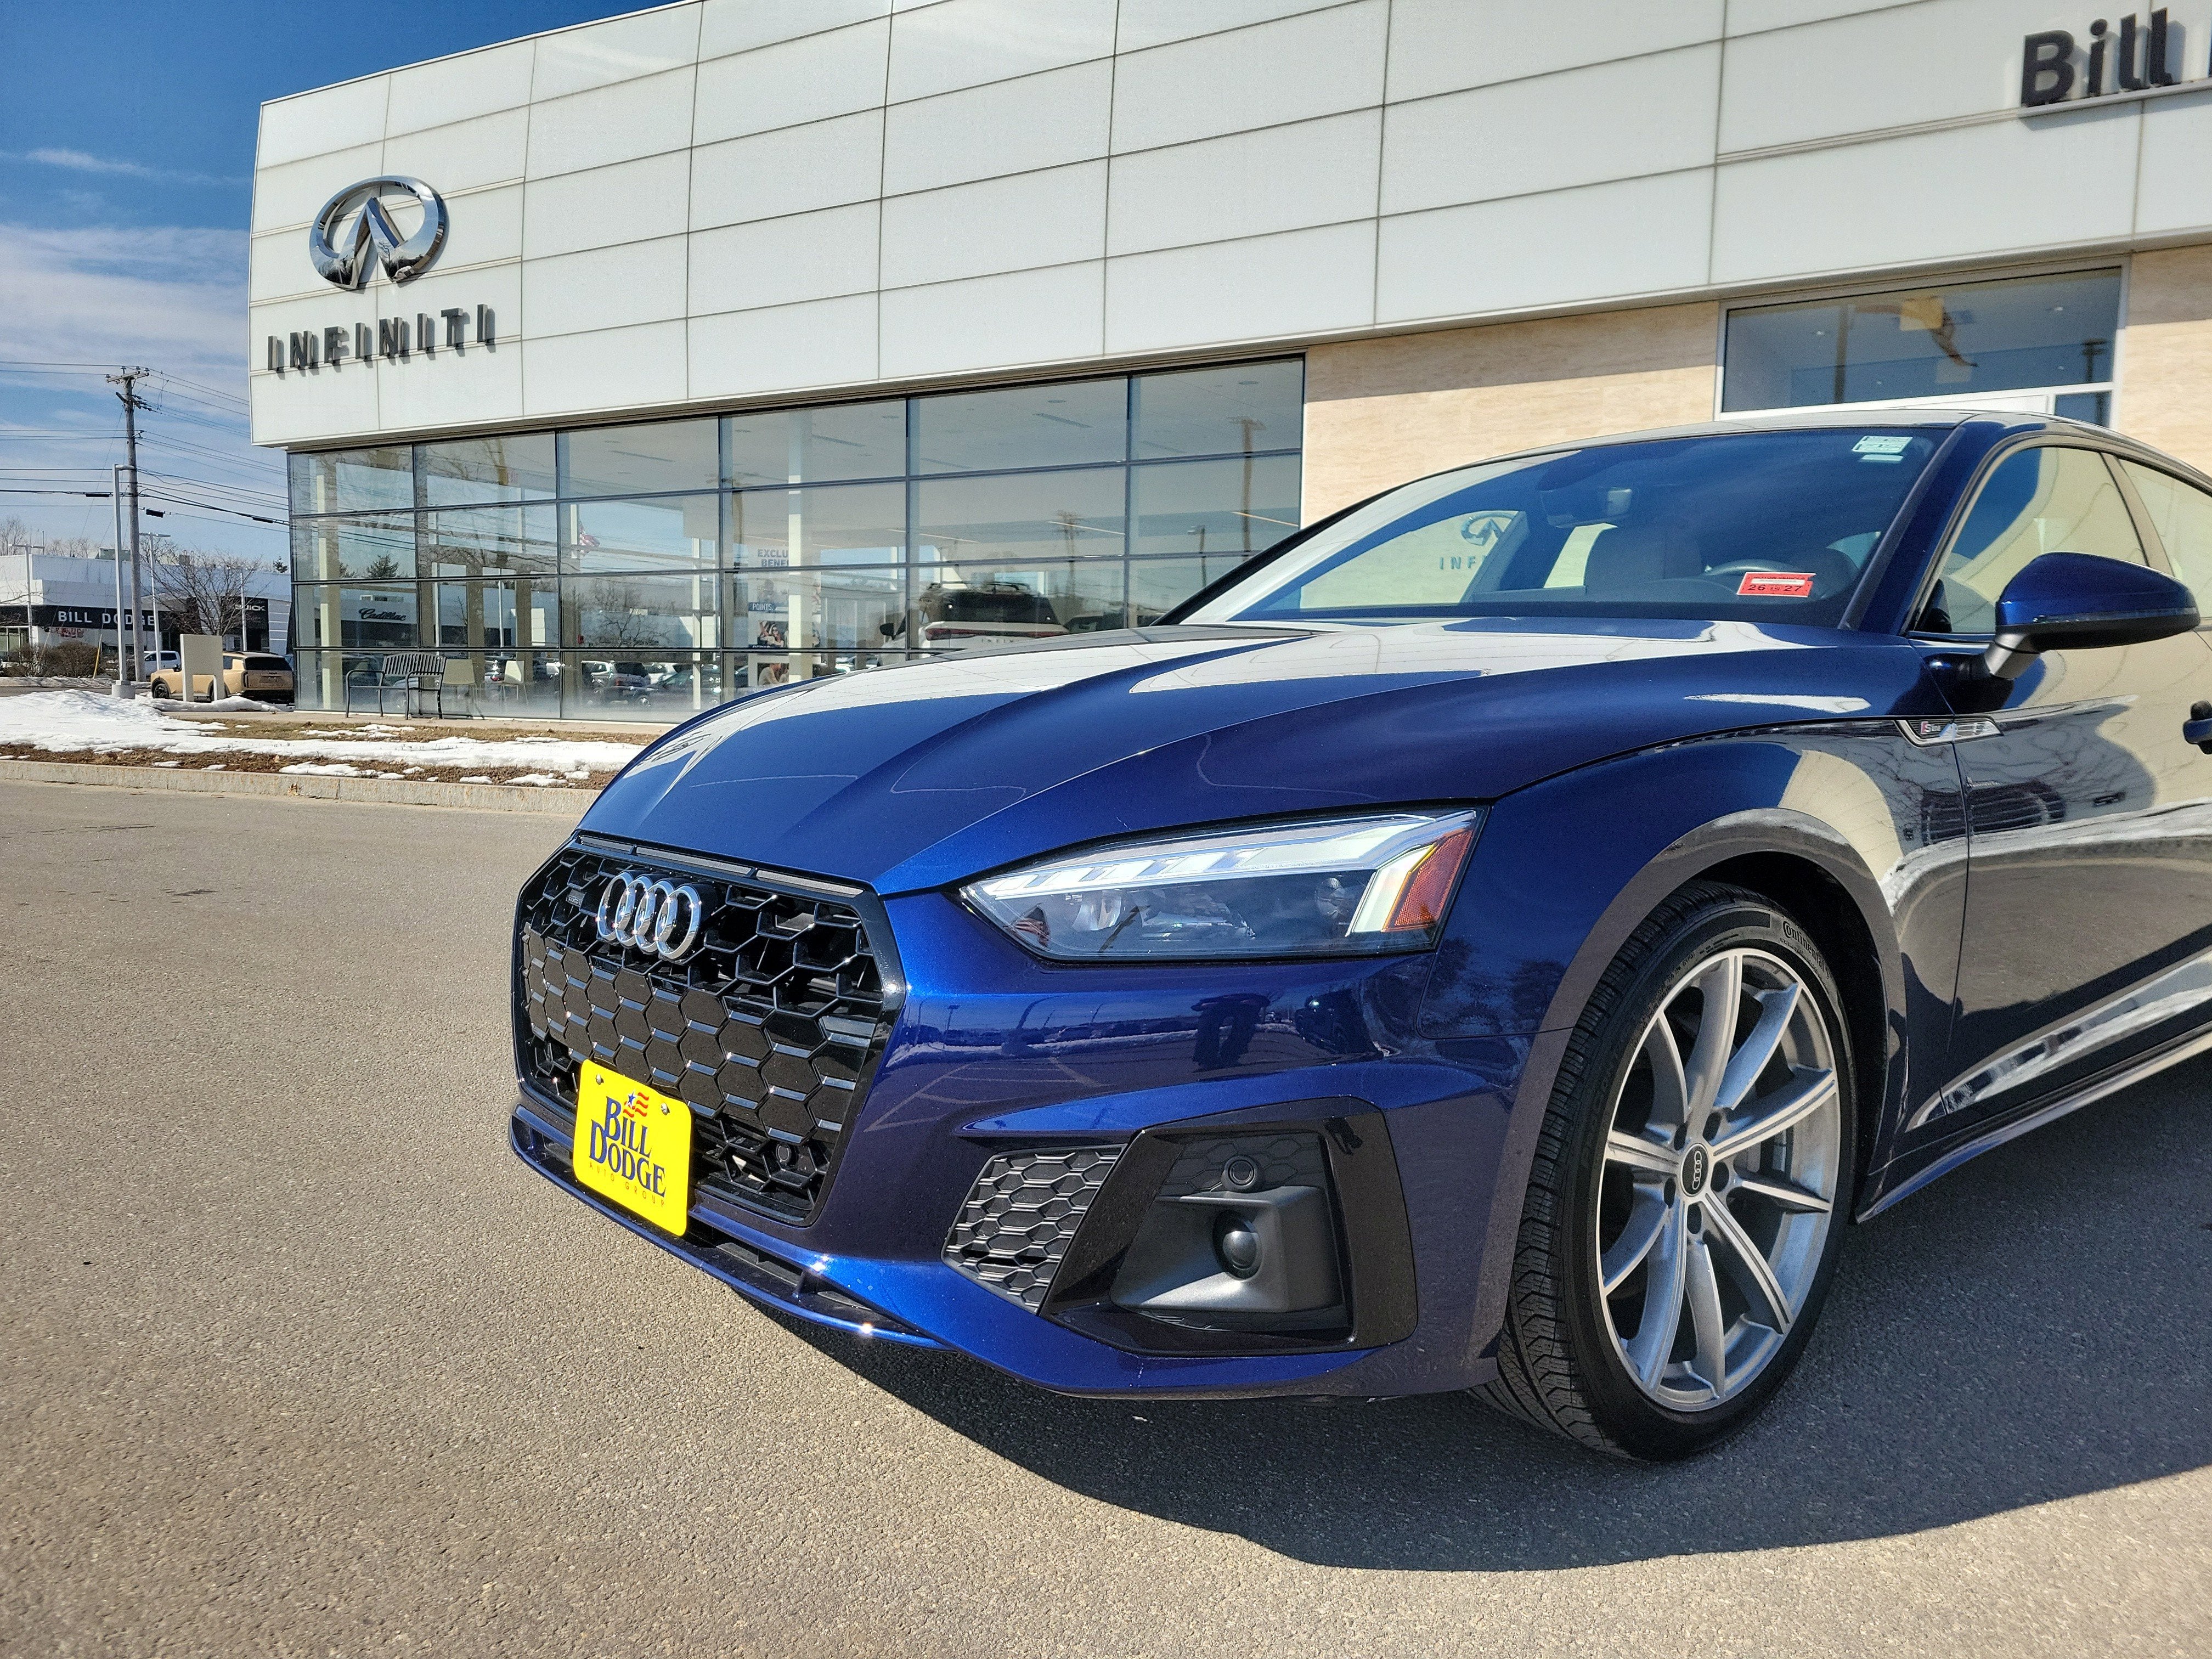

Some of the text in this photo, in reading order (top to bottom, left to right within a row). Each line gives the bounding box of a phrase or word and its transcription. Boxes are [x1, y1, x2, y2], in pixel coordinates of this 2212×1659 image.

[2021, 7, 2174, 107] Bill
[268, 303, 488, 371] INFINITI
[758, 549, 788, 558] EXCLU
[1440, 555, 1486, 569] INF
[58, 611, 92, 623] BILL
[359, 607, 406, 620] Cadillac
[1782, 921, 1825, 972] Continental
[605, 1096, 652, 1158] BILL
[589, 1119, 667, 1198] DODGE
[589, 1161, 665, 1208] AUTO GROUP
